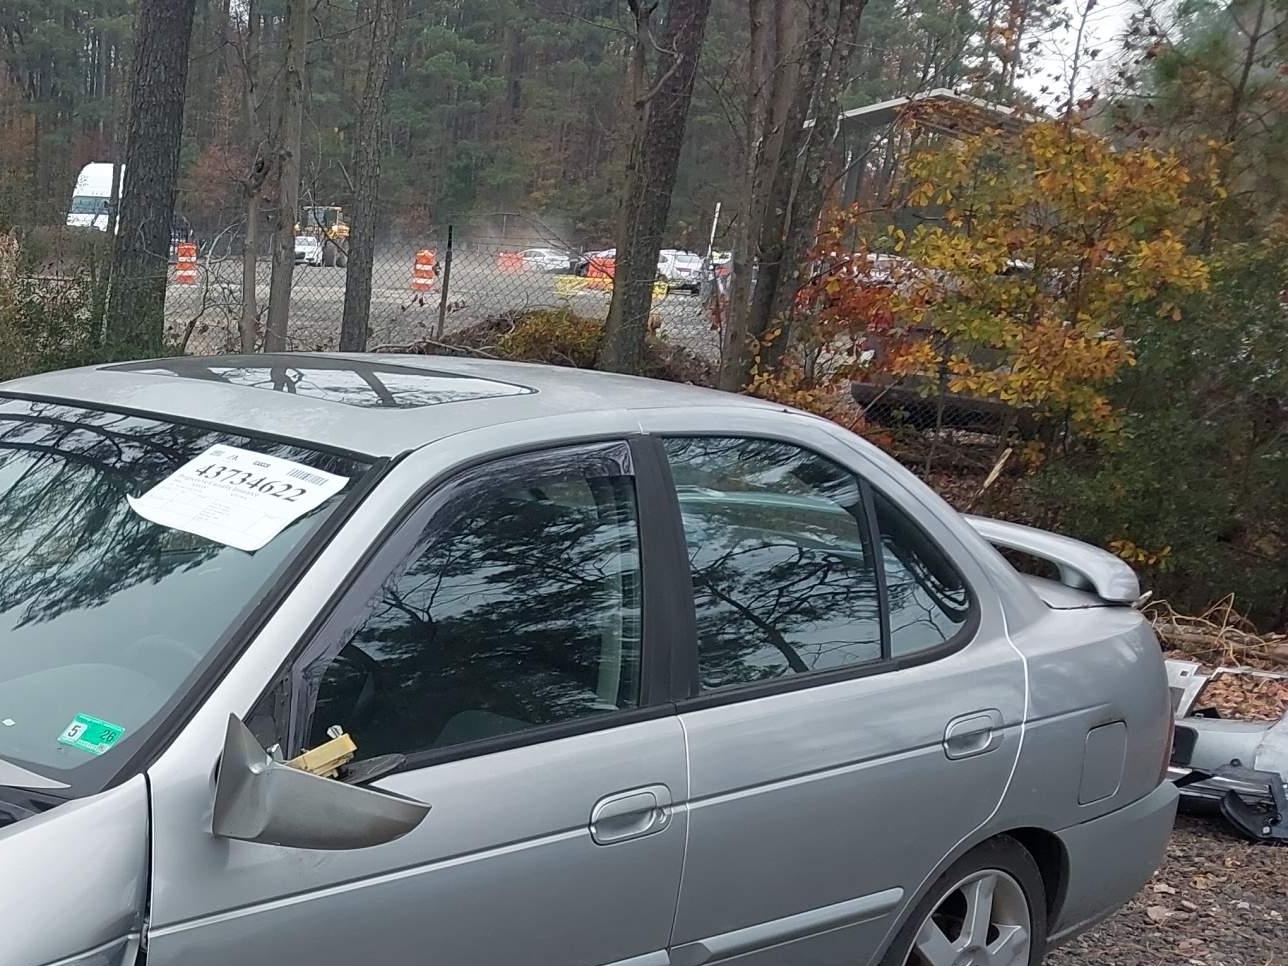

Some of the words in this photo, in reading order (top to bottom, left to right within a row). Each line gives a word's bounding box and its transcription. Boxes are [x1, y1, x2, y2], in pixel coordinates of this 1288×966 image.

[194, 463, 307, 502] 43734622
[67, 724, 81, 737] 5
[100, 729, 116, 742] 26
